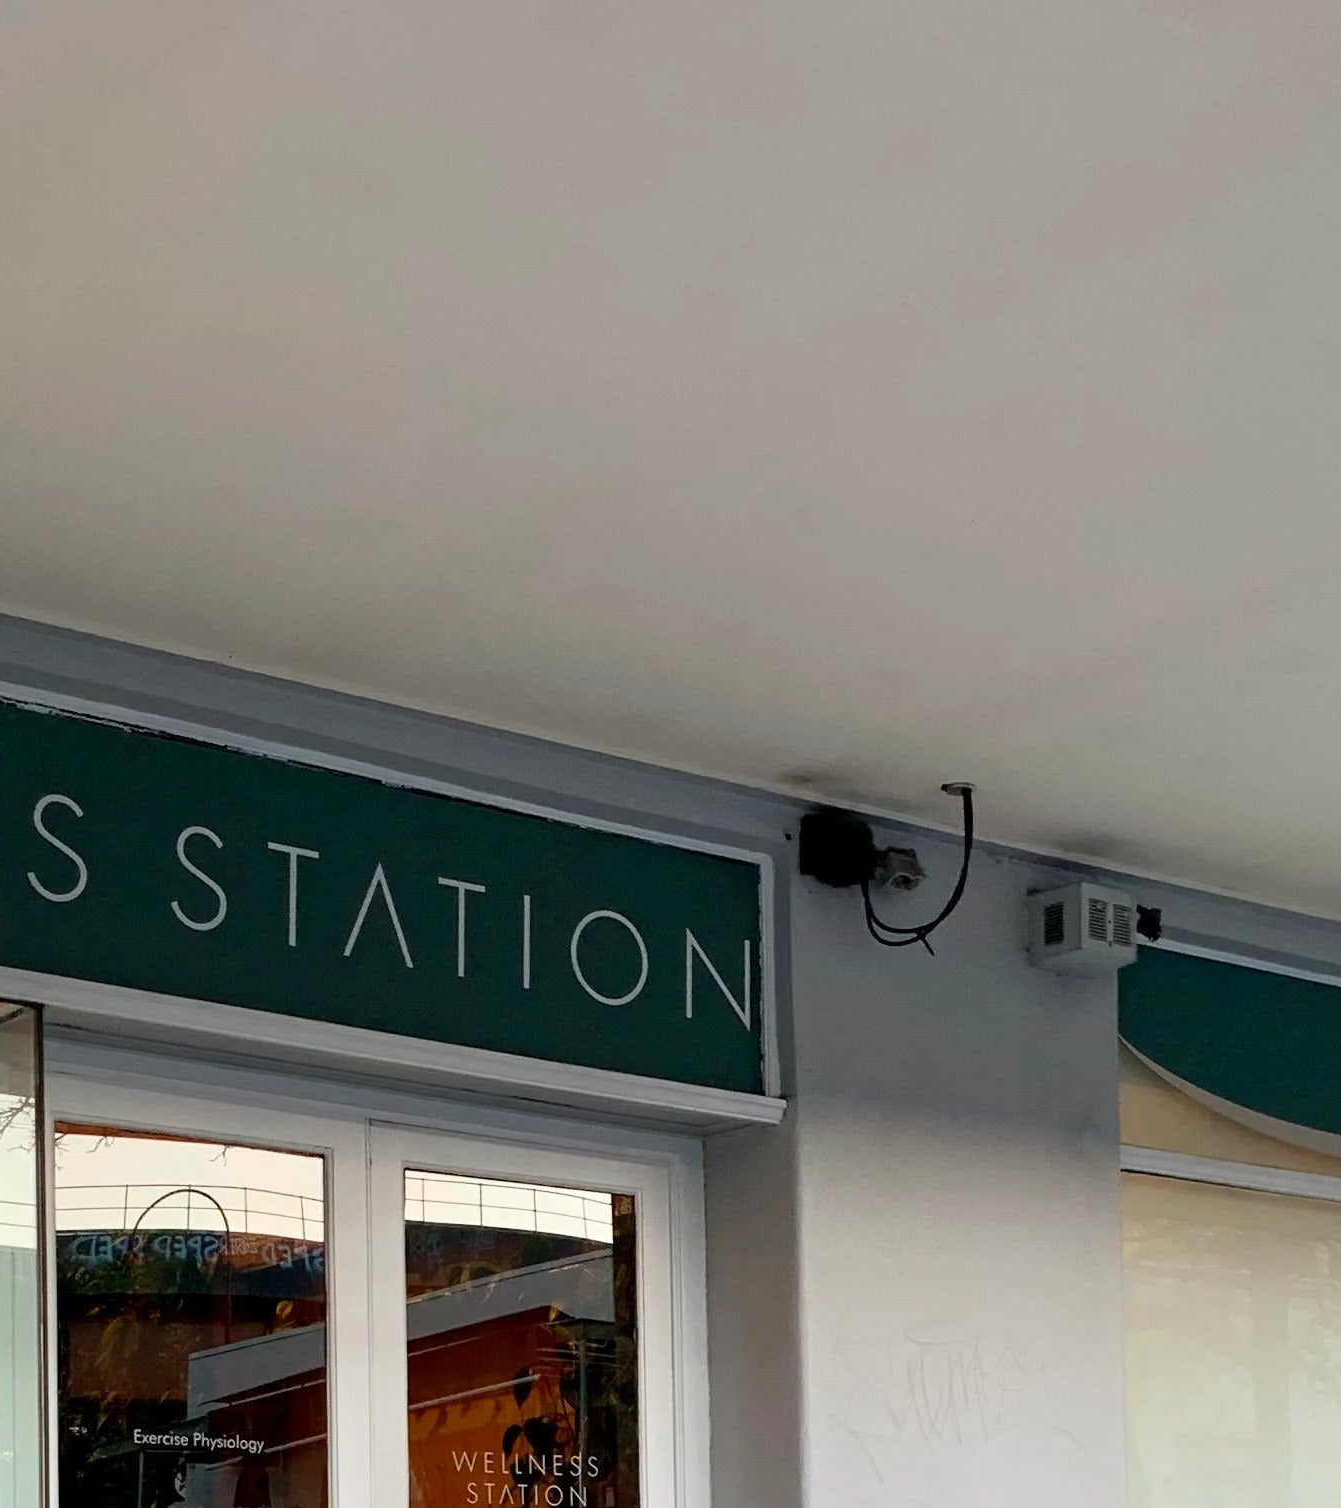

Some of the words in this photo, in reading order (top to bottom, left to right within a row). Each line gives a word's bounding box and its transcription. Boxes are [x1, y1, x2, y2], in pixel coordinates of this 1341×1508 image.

[170, 825, 753, 1032] STATION
[133, 1429, 189, 1446] Exercise
[193, 1431, 265, 1454] Physiology
[451, 1450, 600, 1478] WELLNESS
[466, 1482, 588, 1507] STATION
